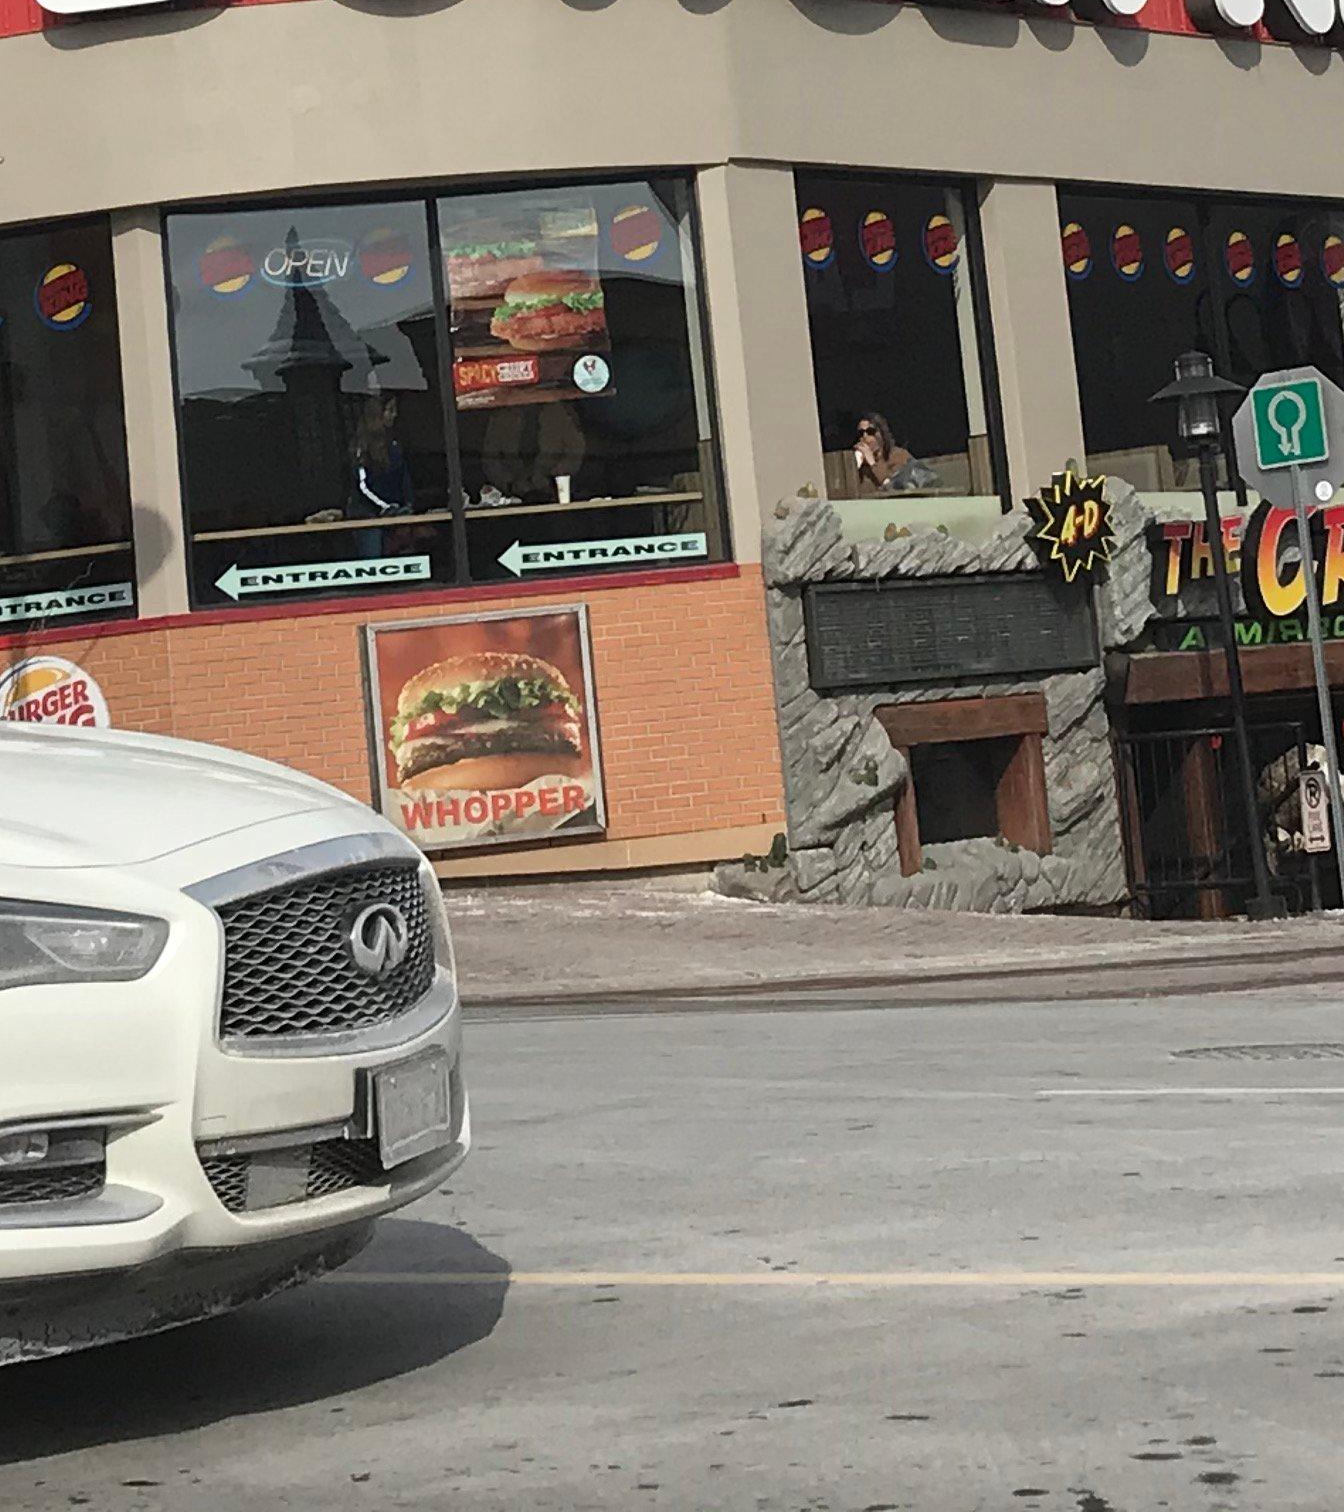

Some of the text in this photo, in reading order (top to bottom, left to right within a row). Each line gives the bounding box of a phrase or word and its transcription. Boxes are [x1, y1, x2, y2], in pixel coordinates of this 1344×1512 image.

[264, 247, 350, 277] OPEN
[522, 538, 702, 566] ENTRANCE
[1163, 516, 1244, 596] THE
[238, 561, 424, 588] ENTRANCE
[1179, 626, 1206, 651] A
[0, 679, 90, 723] URGER
[400, 784, 587, 833] WHOPPER
